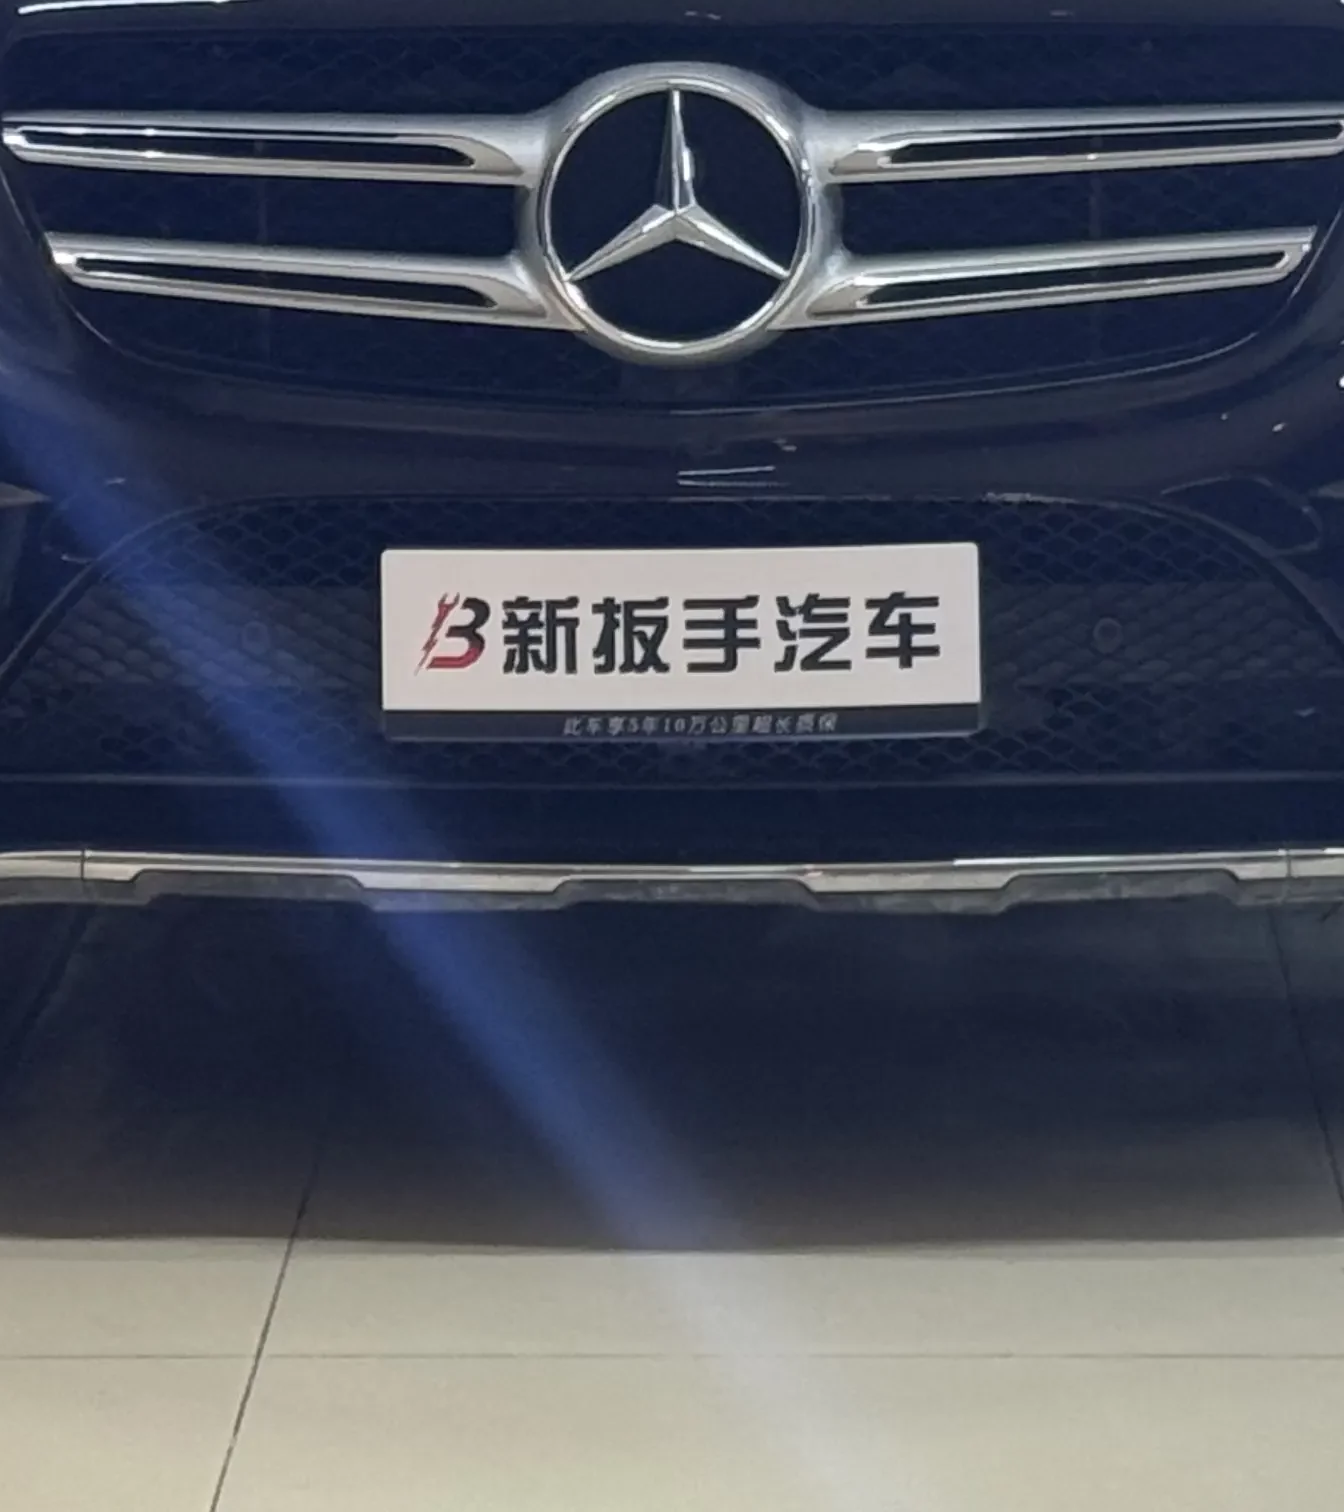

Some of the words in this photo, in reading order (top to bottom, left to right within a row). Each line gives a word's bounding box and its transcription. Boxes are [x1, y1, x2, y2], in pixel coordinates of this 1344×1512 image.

[501, 591, 941, 674] 新扳手汽车
